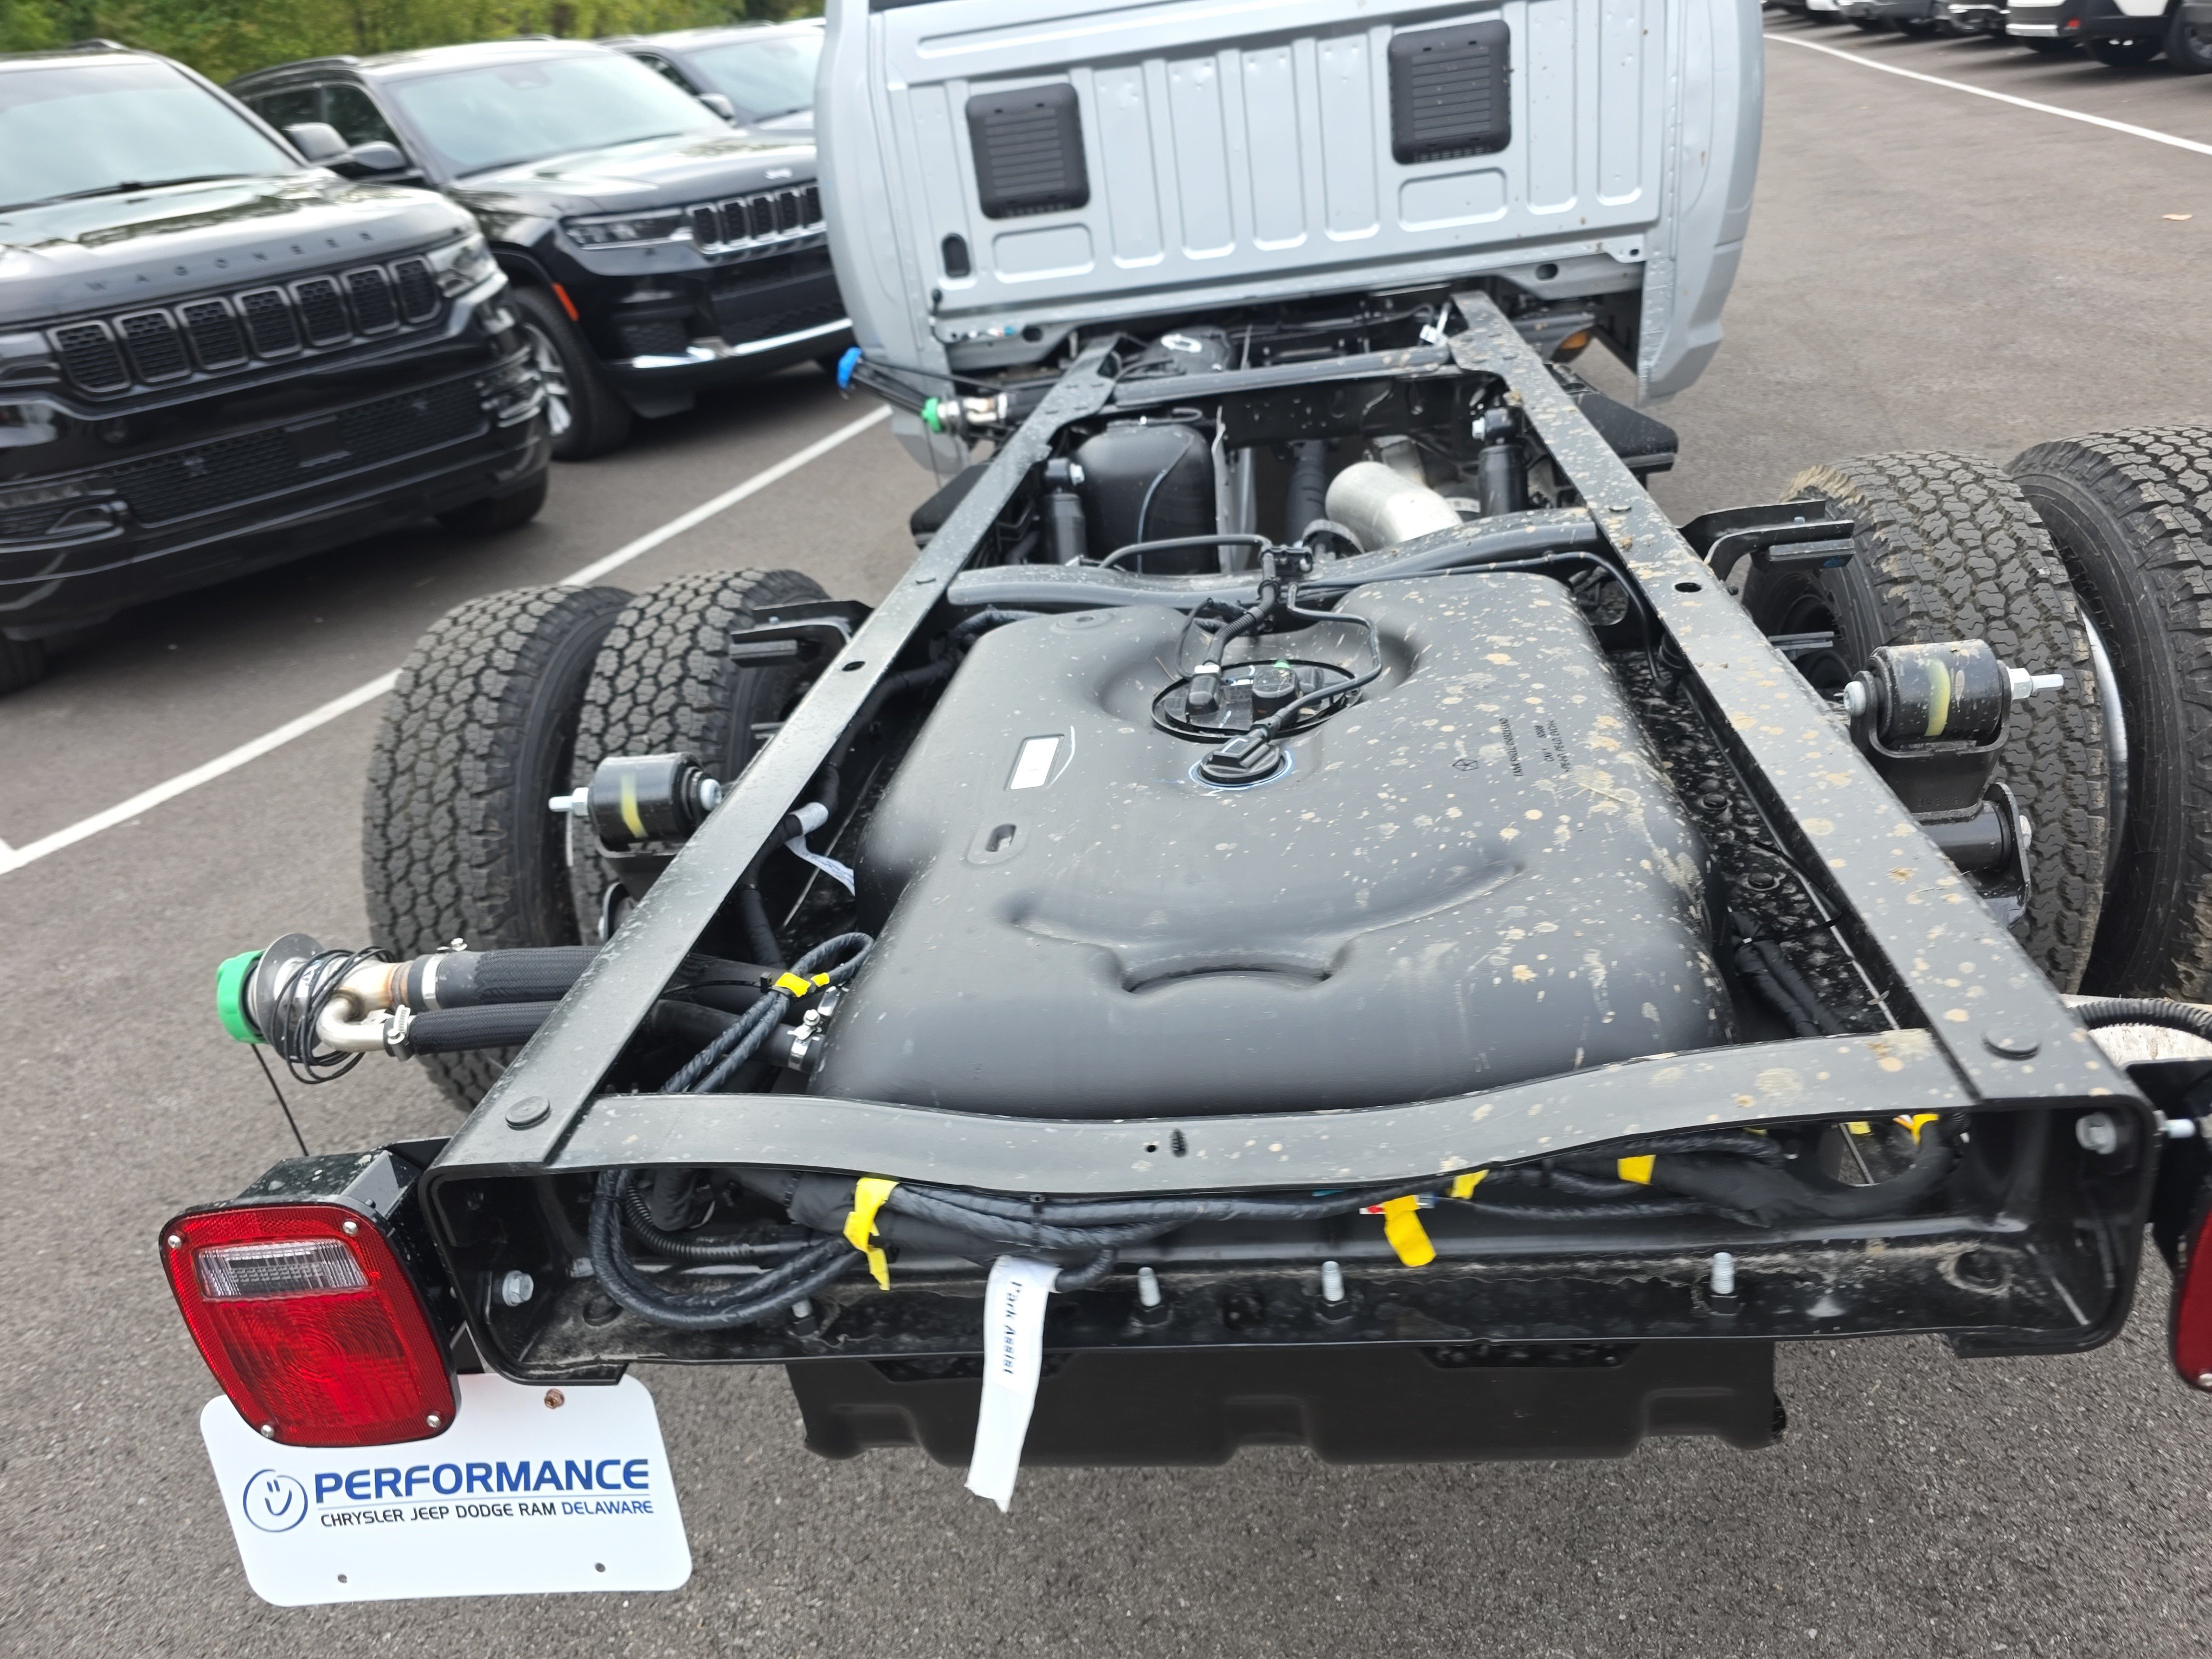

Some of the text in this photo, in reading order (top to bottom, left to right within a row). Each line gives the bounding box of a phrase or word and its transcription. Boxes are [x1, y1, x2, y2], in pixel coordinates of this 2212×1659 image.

[85, 230, 375, 292] WAGONEER
[1002, 1281, 1023, 1374] Park Assist
[314, 1458, 649, 1504] PERFORMANCE
[320, 1500, 653, 1527] CHRYSLER JEEP DODGE RAM DELAWARE
